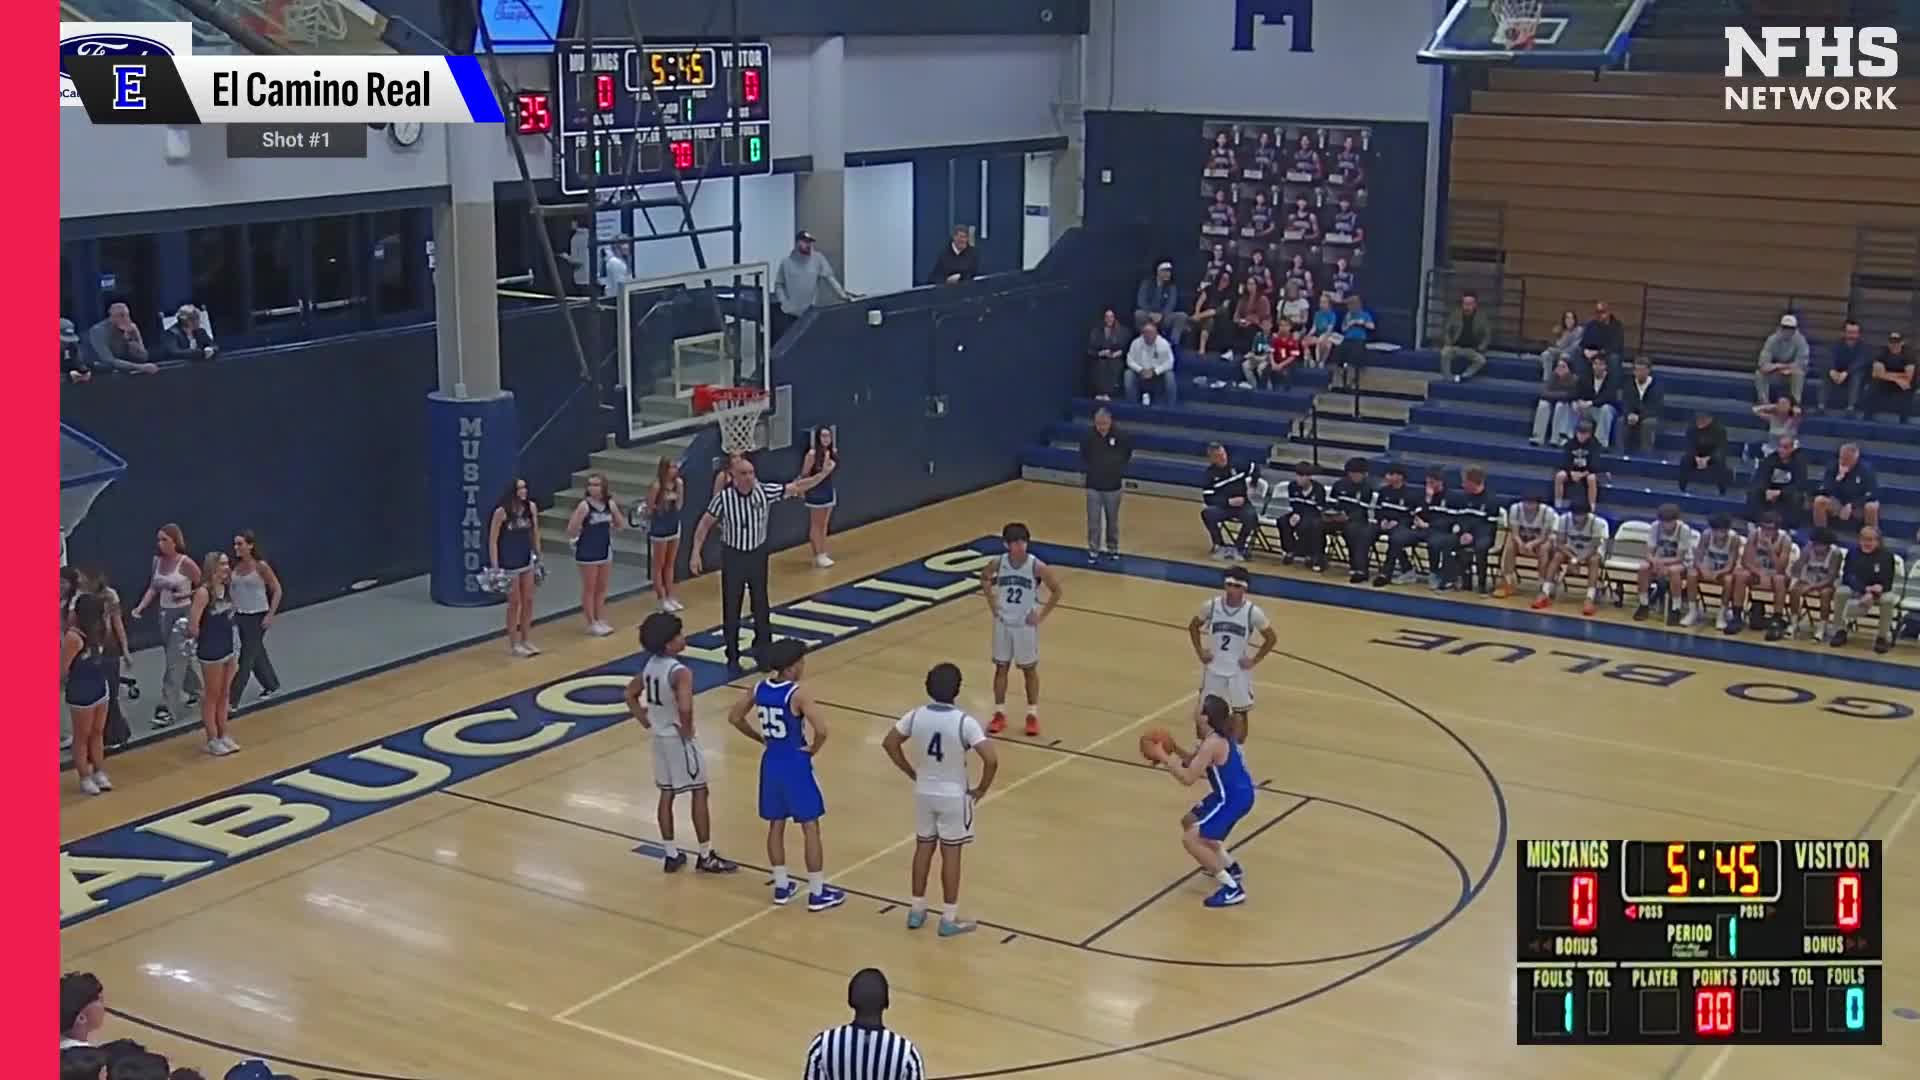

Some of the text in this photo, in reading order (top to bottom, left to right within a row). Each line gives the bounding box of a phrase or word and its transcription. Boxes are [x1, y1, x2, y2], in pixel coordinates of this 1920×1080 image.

[651, 52, 704, 85] 5:45
[721, 50, 763, 67] VIITOR
[1006, 588, 1023, 604] 22
[1221, 635, 1231, 651] 2
[1369, 629, 1915, 720] GO BLUE
[645, 675, 663, 707] 11
[758, 706, 787, 739] 25
[928, 732, 944, 762] 4
